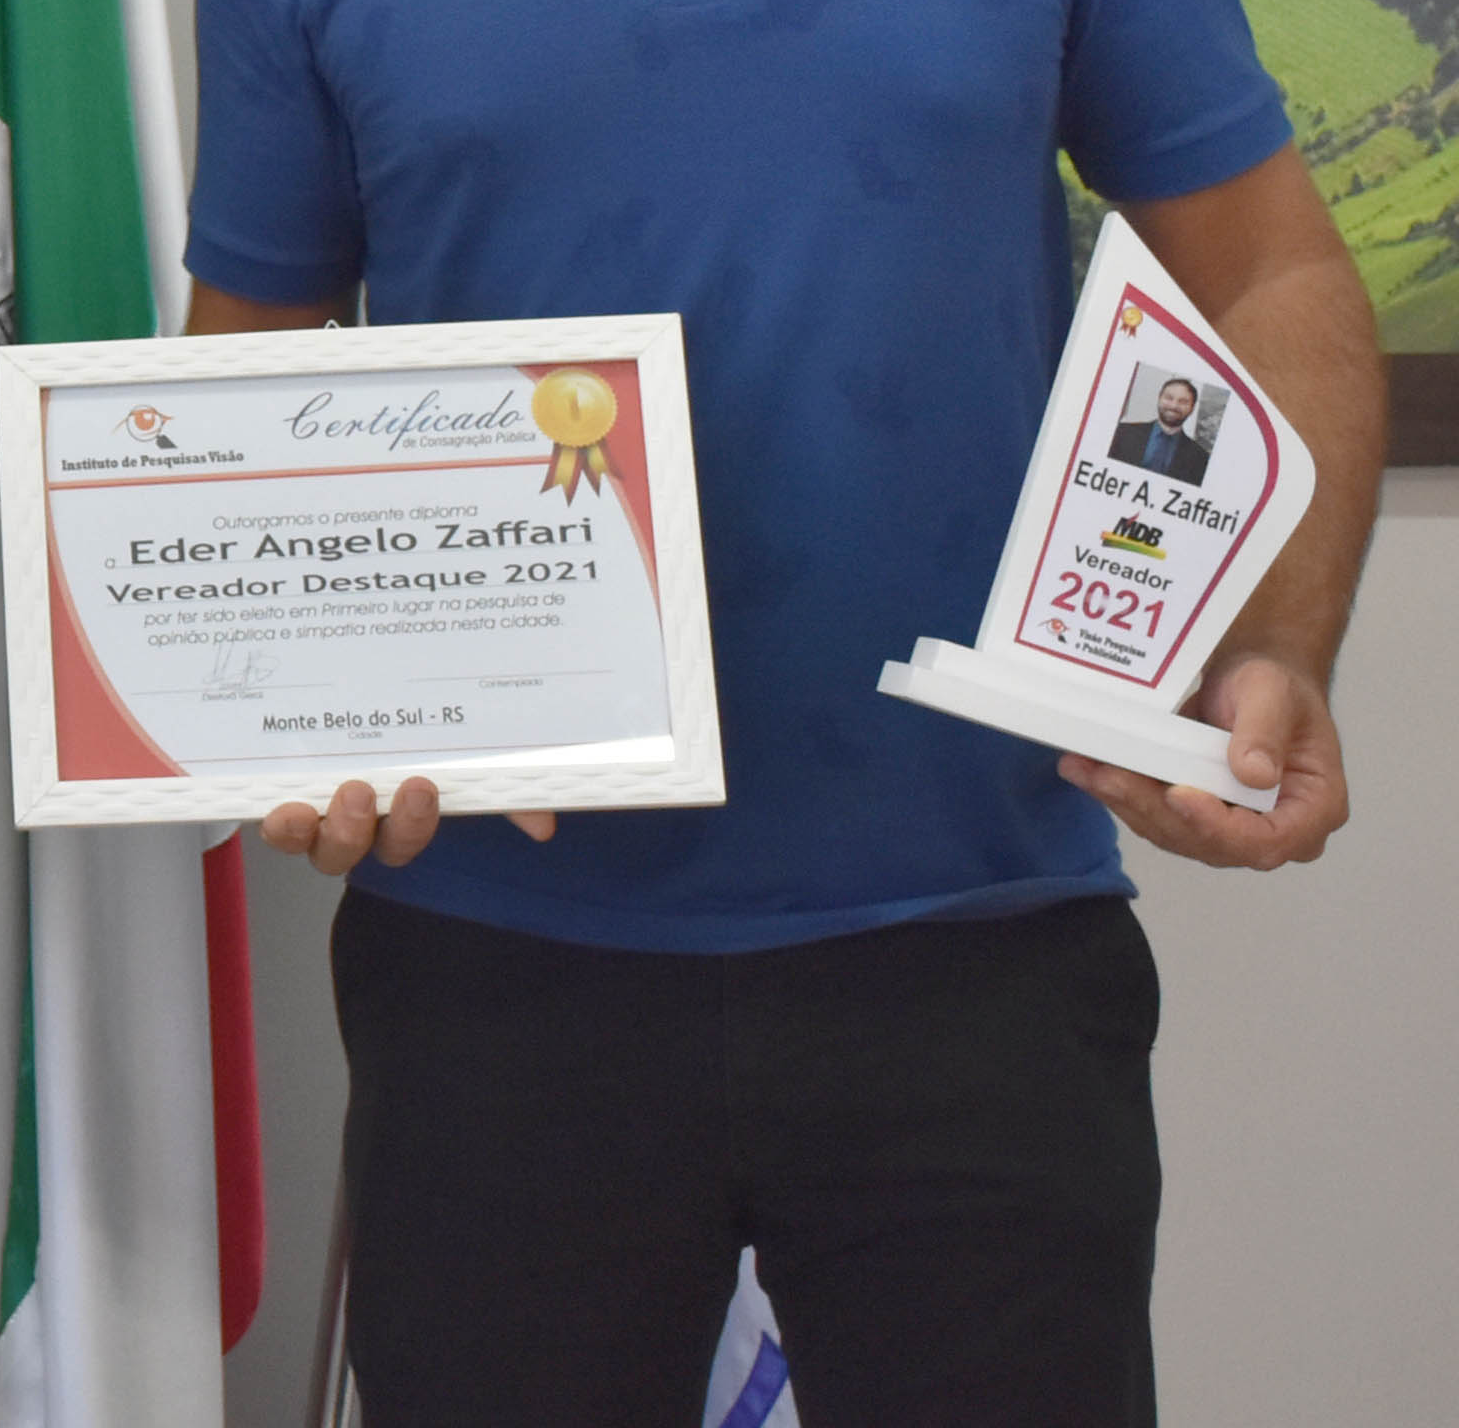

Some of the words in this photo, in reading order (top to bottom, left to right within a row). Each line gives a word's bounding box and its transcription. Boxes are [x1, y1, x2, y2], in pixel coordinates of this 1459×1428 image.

[283, 389, 524, 452] Certificado
[402, 436, 417, 448] de
[420, 433, 492, 450] Consagração
[495, 430, 536, 445] Pública
[62, 458, 118, 471] Instituto
[121, 456, 137, 468] de
[140, 452, 207, 469] Pesquisas
[208, 449, 244, 463] Visão
[1073, 460, 1130, 499] Eder
[1131, 479, 1155, 509] A.
[1162, 488, 1241, 535] Zaffari
[213, 512, 314, 532] Outorgamos
[318, 513, 330, 525] o
[334, 507, 404, 525] presente
[409, 503, 478, 522] diploma
[1112, 516, 1164, 548] MDB
[104, 558, 116, 569] a
[130, 537, 238, 565] Eder
[254, 527, 417, 562] Angelo
[434, 517, 593, 551] Zaffari
[107, 577, 287, 603] Vereador
[303, 570, 487, 594] Destaque
[503, 560, 598, 584] 2021
[1074, 545, 1173, 592] Vereador
[144, 612, 172, 628] por
[177, 610, 198, 624] ter
[203, 608, 235, 623] sido
[240, 605, 285, 621] eleito
[289, 606, 317, 618] em
[321, 600, 388, 617] Primeiro
[392, 598, 434, 617] lugar
[439, 598, 461, 611] na
[465, 593, 539, 613] pesquisa
[543, 592, 565, 607] de
[1050, 571, 1165, 639] 2021
[147, 630, 209, 647] opinião
[213, 627, 276, 645] pública
[280, 629, 291, 640] e
[296, 621, 365, 641] simpatia
[370, 618, 447, 636] realizada
[451, 616, 496, 632] nesta
[500, 612, 565, 629] cidade.
[263, 714, 318, 732] Monte
[323, 710, 363, 729] Belo
[369, 710, 390, 726] do
[396, 707, 423, 725] Sul
[442, 706, 465, 723] RS
